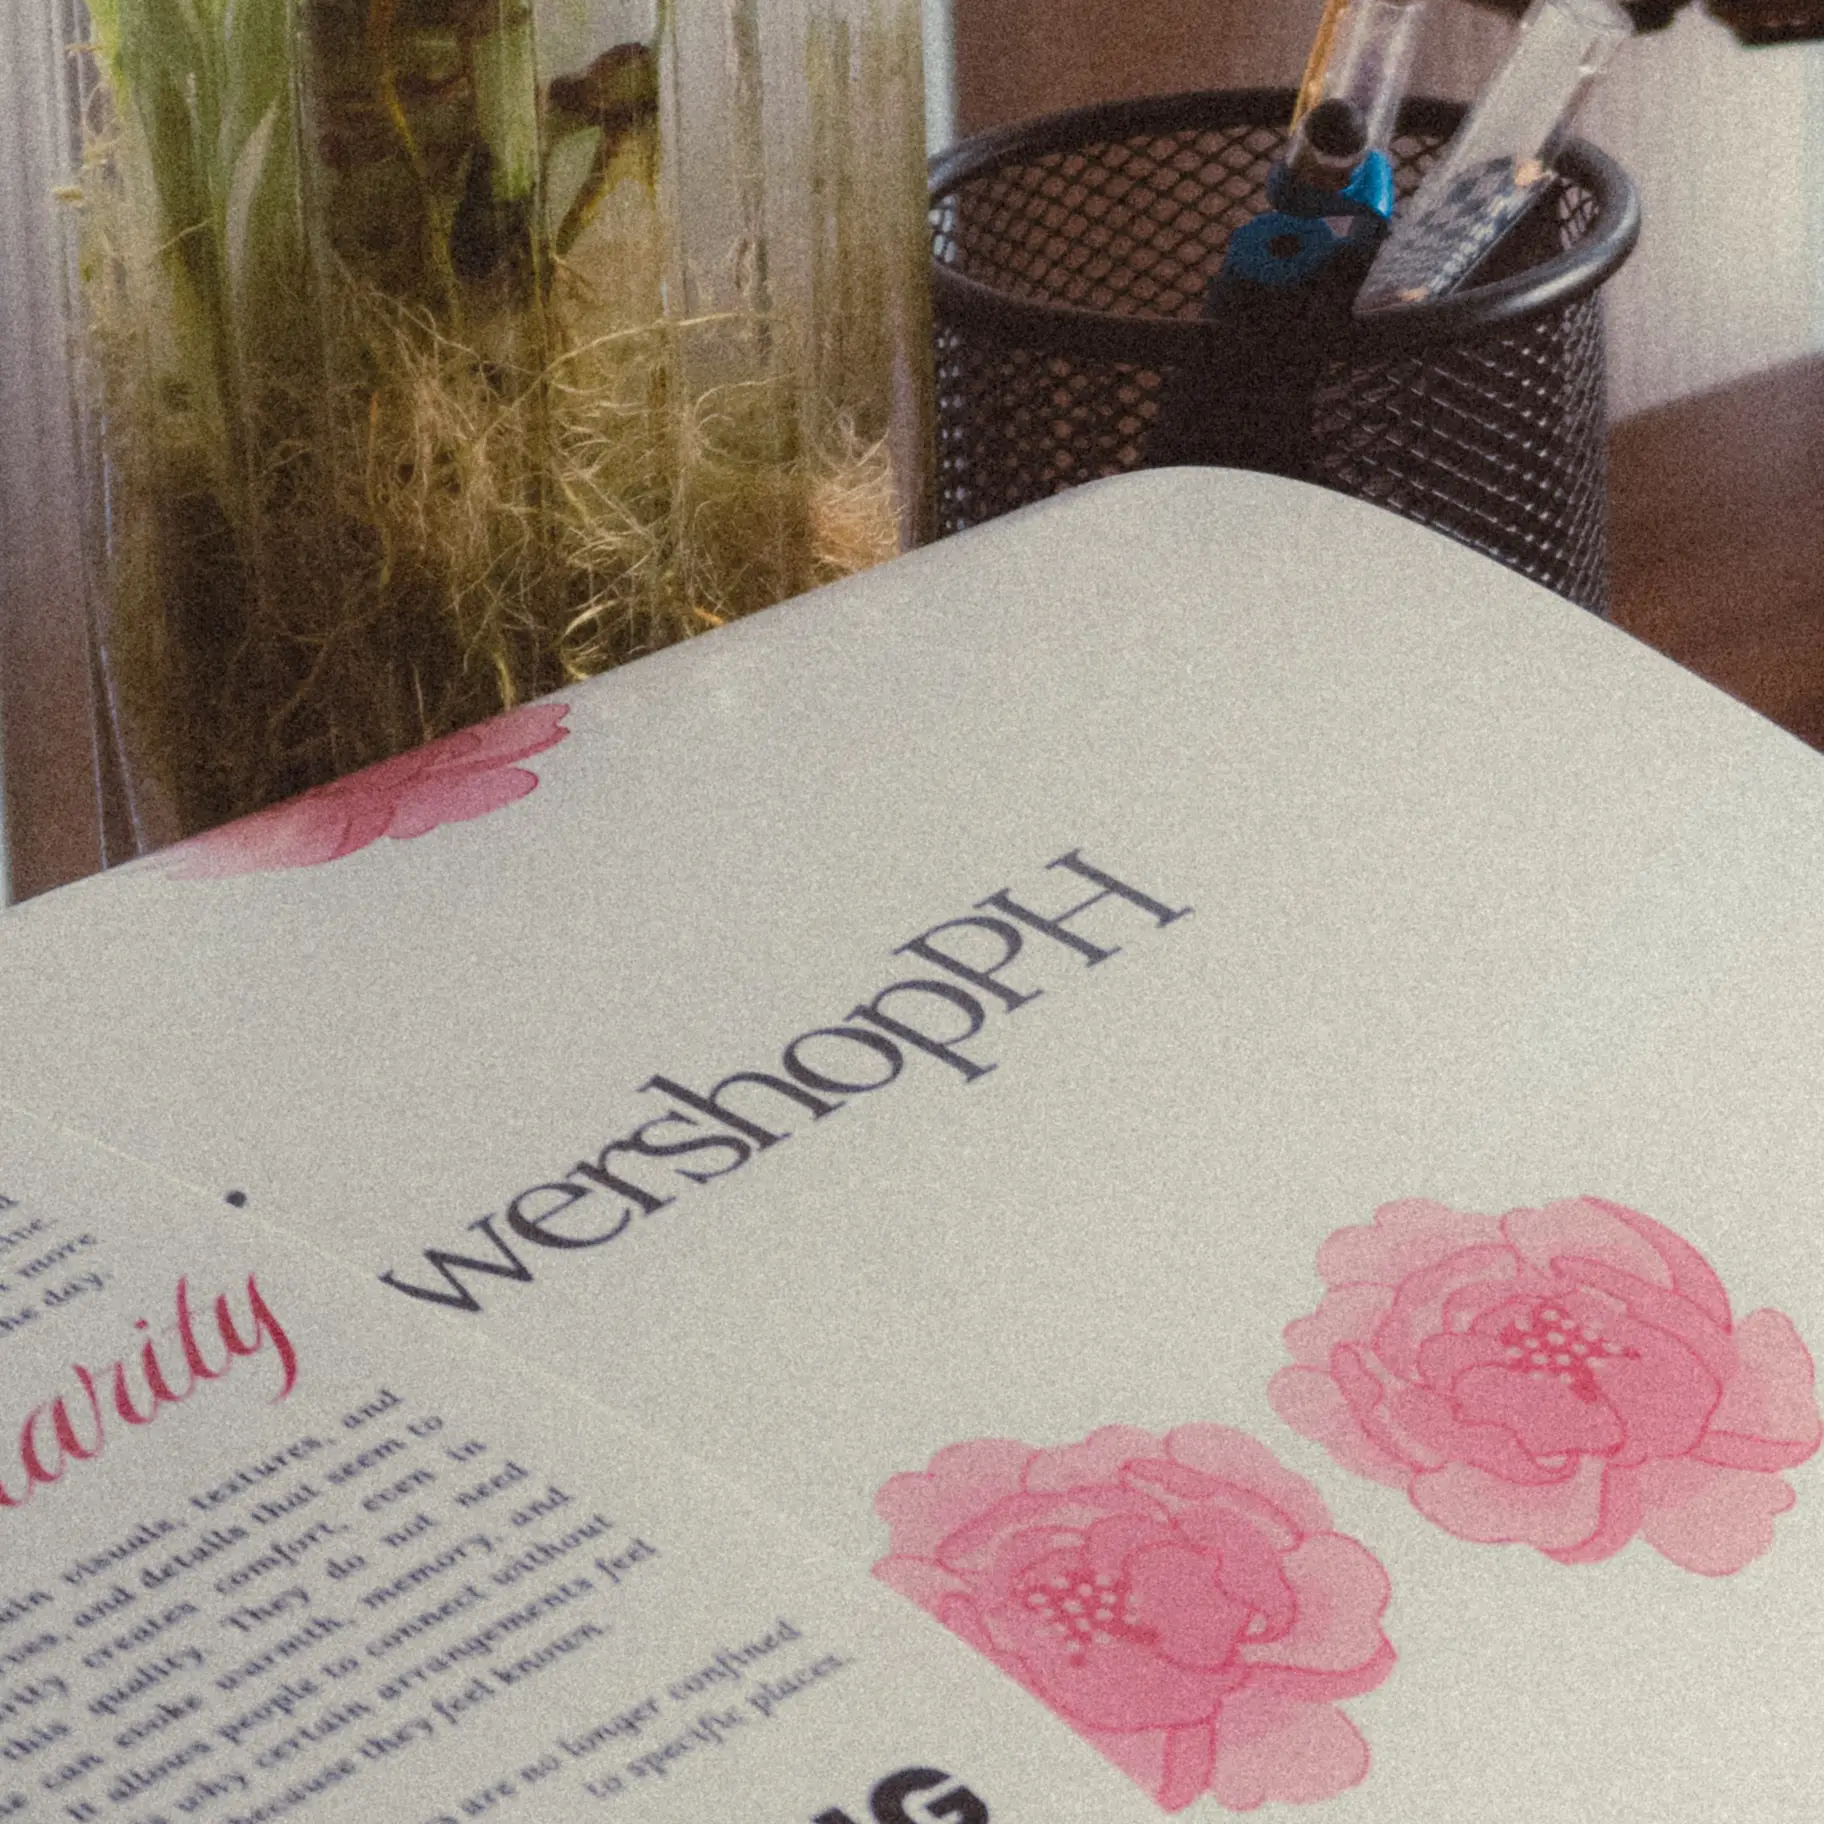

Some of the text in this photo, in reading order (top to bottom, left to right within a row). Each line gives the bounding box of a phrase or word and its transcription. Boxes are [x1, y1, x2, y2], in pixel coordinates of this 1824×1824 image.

[59, 1518, 186, 1587] visuals,
[188, 1435, 334, 1512] textures,
[340, 1386, 403, 1430] and
[72, 1583, 137, 1629] and
[139, 1524, 248, 1590] details
[249, 1482, 320, 1526] that
[324, 1437, 406, 1485] seem
[404, 1414, 445, 1438] to
[81, 1600, 199, 1669] creates
[360, 1467, 437, 1513] even
[445, 1439, 487, 1464] in
[220, 1585, 312, 1633] They
[325, 1553, 368, 1581] do
[380, 1511, 438, 1549] not
[453, 1459, 530, 1508] need
[39, 1751, 106, 1792] can
[509, 1483, 574, 1528] and
[106, 1739, 213, 1804] allows
[215, 1677, 319, 1745] people
[320, 1655, 361, 1680] to
[365, 1583, 487, 1658] connect
[489, 1513, 614, 1586] without
[175, 1770, 250, 1814] why
[253, 1700, 374, 1769] certain
[376, 1576, 594, 1702] arrangements
[593, 1536, 658, 1585] feel
[356, 1716, 436, 1761] they
[429, 1676, 496, 1726] feel
[459, 1779, 517, 1818] are
[517, 1754, 562, 1785] no
[556, 1696, 660, 1758] longer
[666, 1617, 803, 1701] confined
[582, 1772, 626, 1800] to
[625, 1708, 746, 1779] specific
